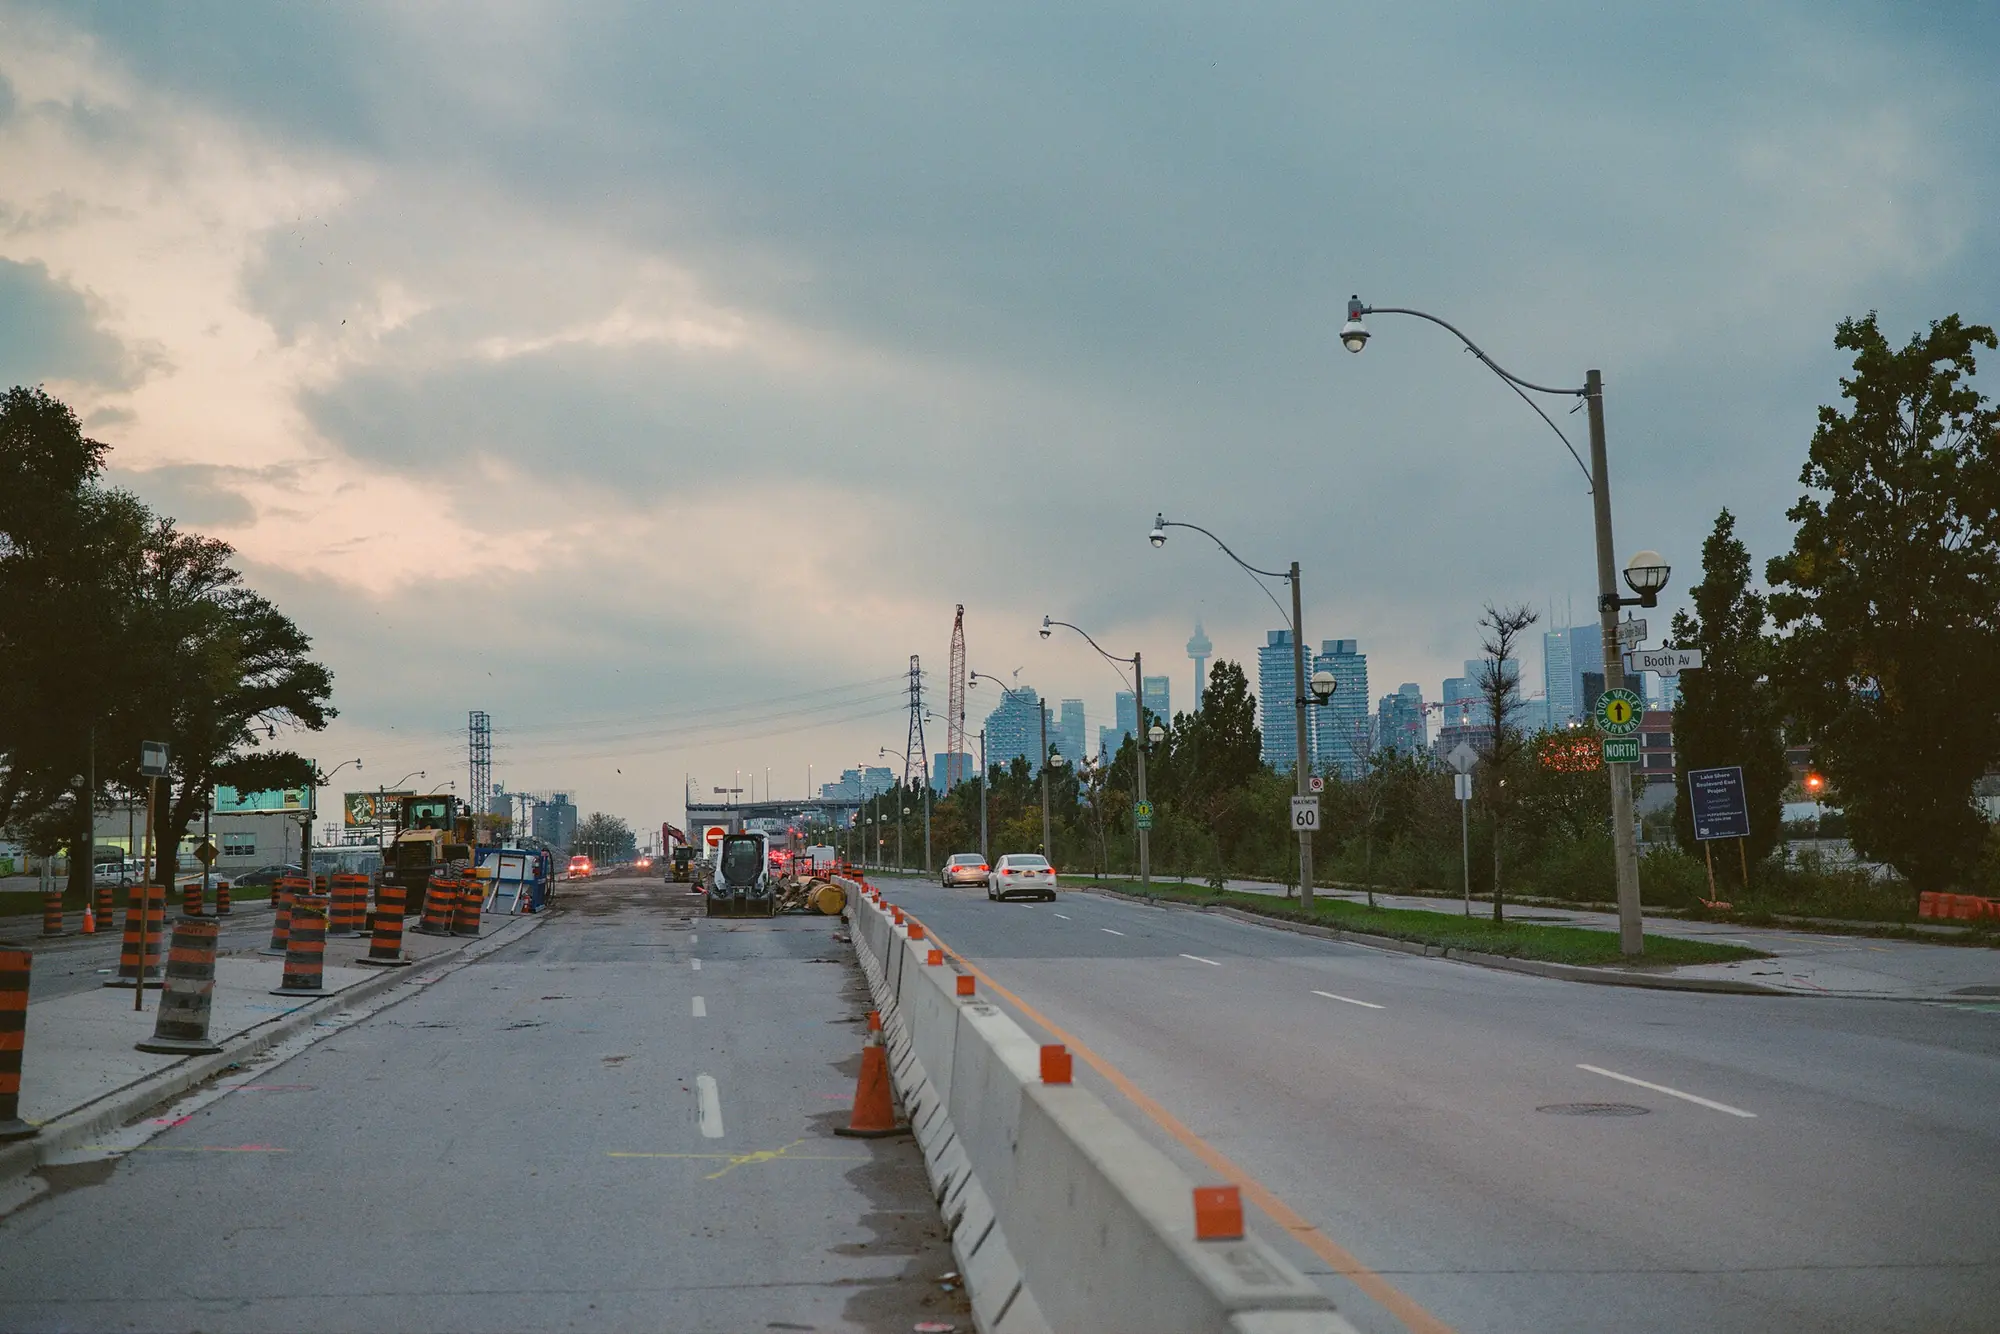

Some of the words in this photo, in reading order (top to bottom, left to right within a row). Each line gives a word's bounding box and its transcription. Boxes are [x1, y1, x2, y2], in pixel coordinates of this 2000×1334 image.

[1644, 655, 1675, 667] Booth
[1678, 655, 1690, 665] Av
[1597, 697, 1610, 715] DON
[1612, 690, 1642, 713] VALLEY
[1601, 717, 1639, 734] PARKWAY
[1606, 744, 1637, 758] NORTH
[1296, 810, 1315, 826] 60
